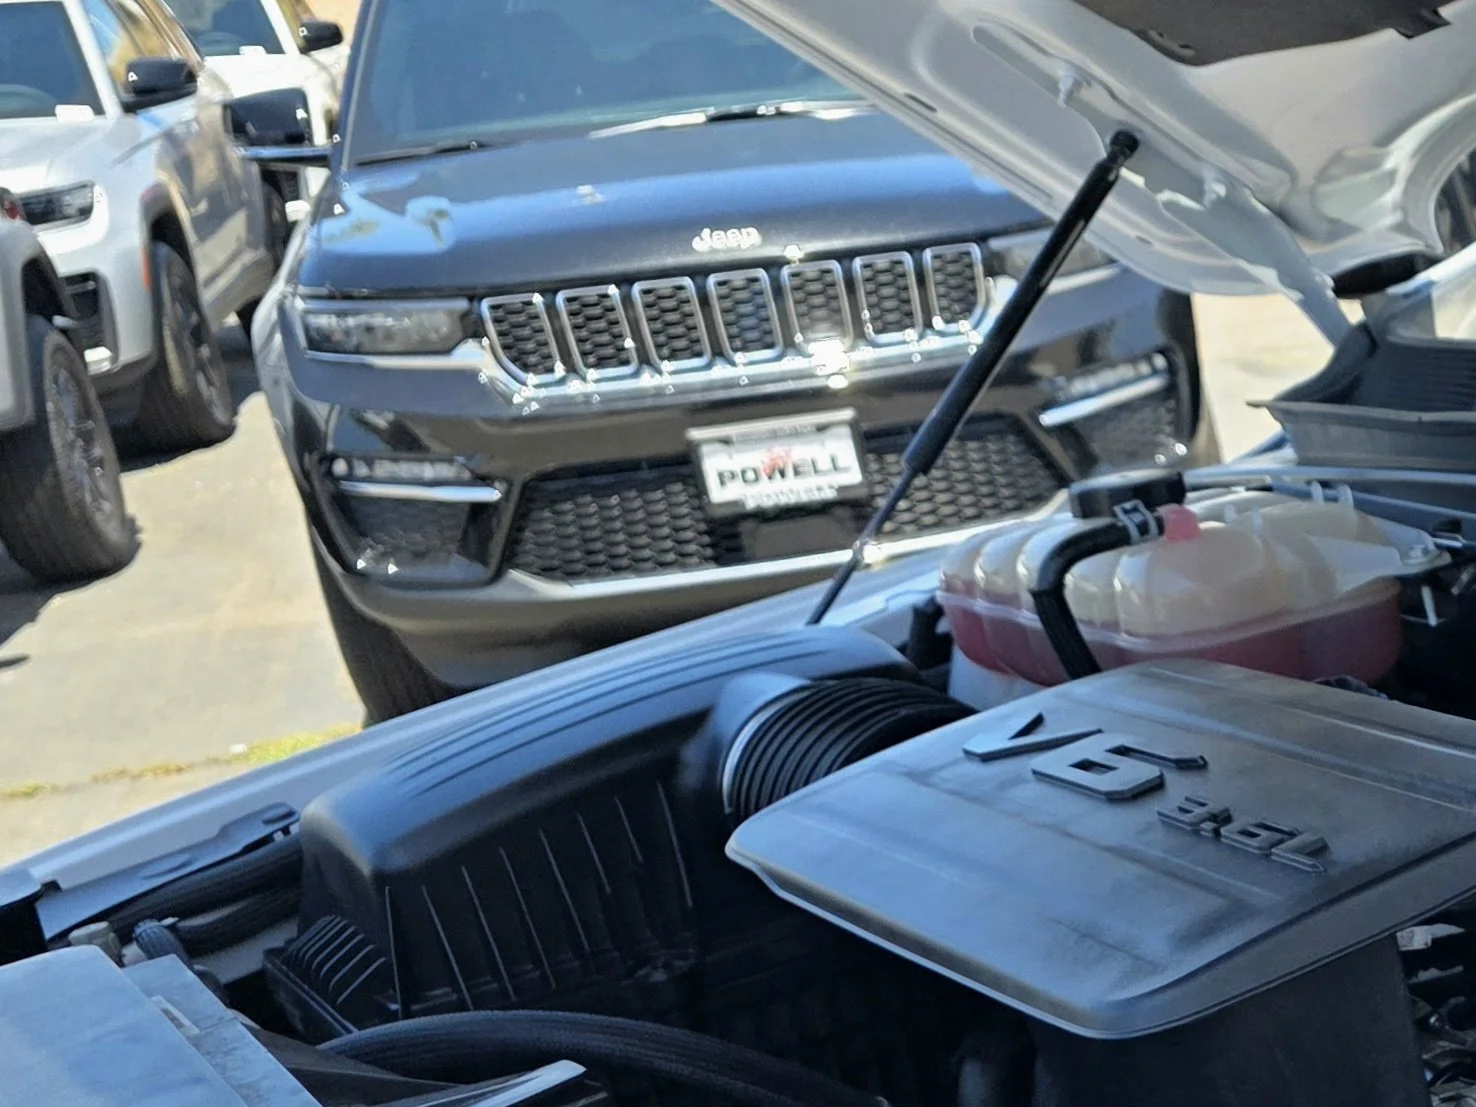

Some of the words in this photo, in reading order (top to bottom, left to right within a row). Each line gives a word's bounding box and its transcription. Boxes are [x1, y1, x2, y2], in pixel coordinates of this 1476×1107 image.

[692, 227, 762, 252] Jeep
[717, 453, 853, 489] POWELL
[962, 711, 1209, 801] V6
[1156, 795, 1331, 873] 3.6L
